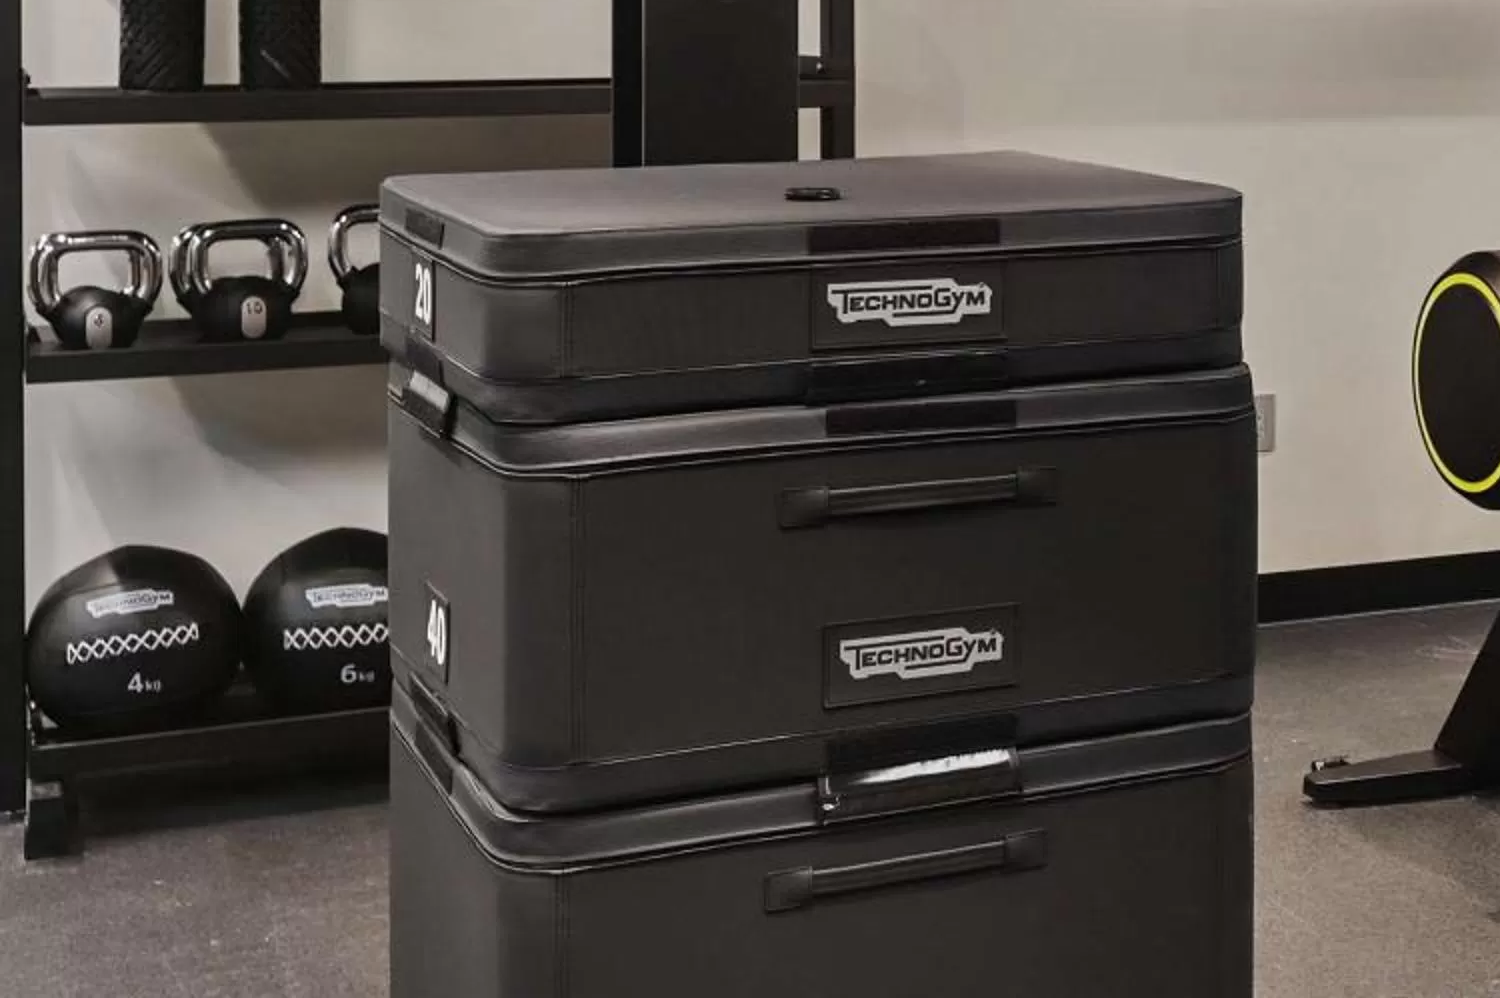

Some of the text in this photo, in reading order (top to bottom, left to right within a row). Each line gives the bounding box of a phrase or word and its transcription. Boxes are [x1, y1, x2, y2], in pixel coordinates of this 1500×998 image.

[247, 301, 263, 315] 10
[416, 263, 431, 324] 20
[831, 285, 986, 318] TECHNOGYM
[88, 590, 171, 615] NOGYM
[427, 600, 446, 664] 40
[844, 635, 997, 670] TECHNOGYM
